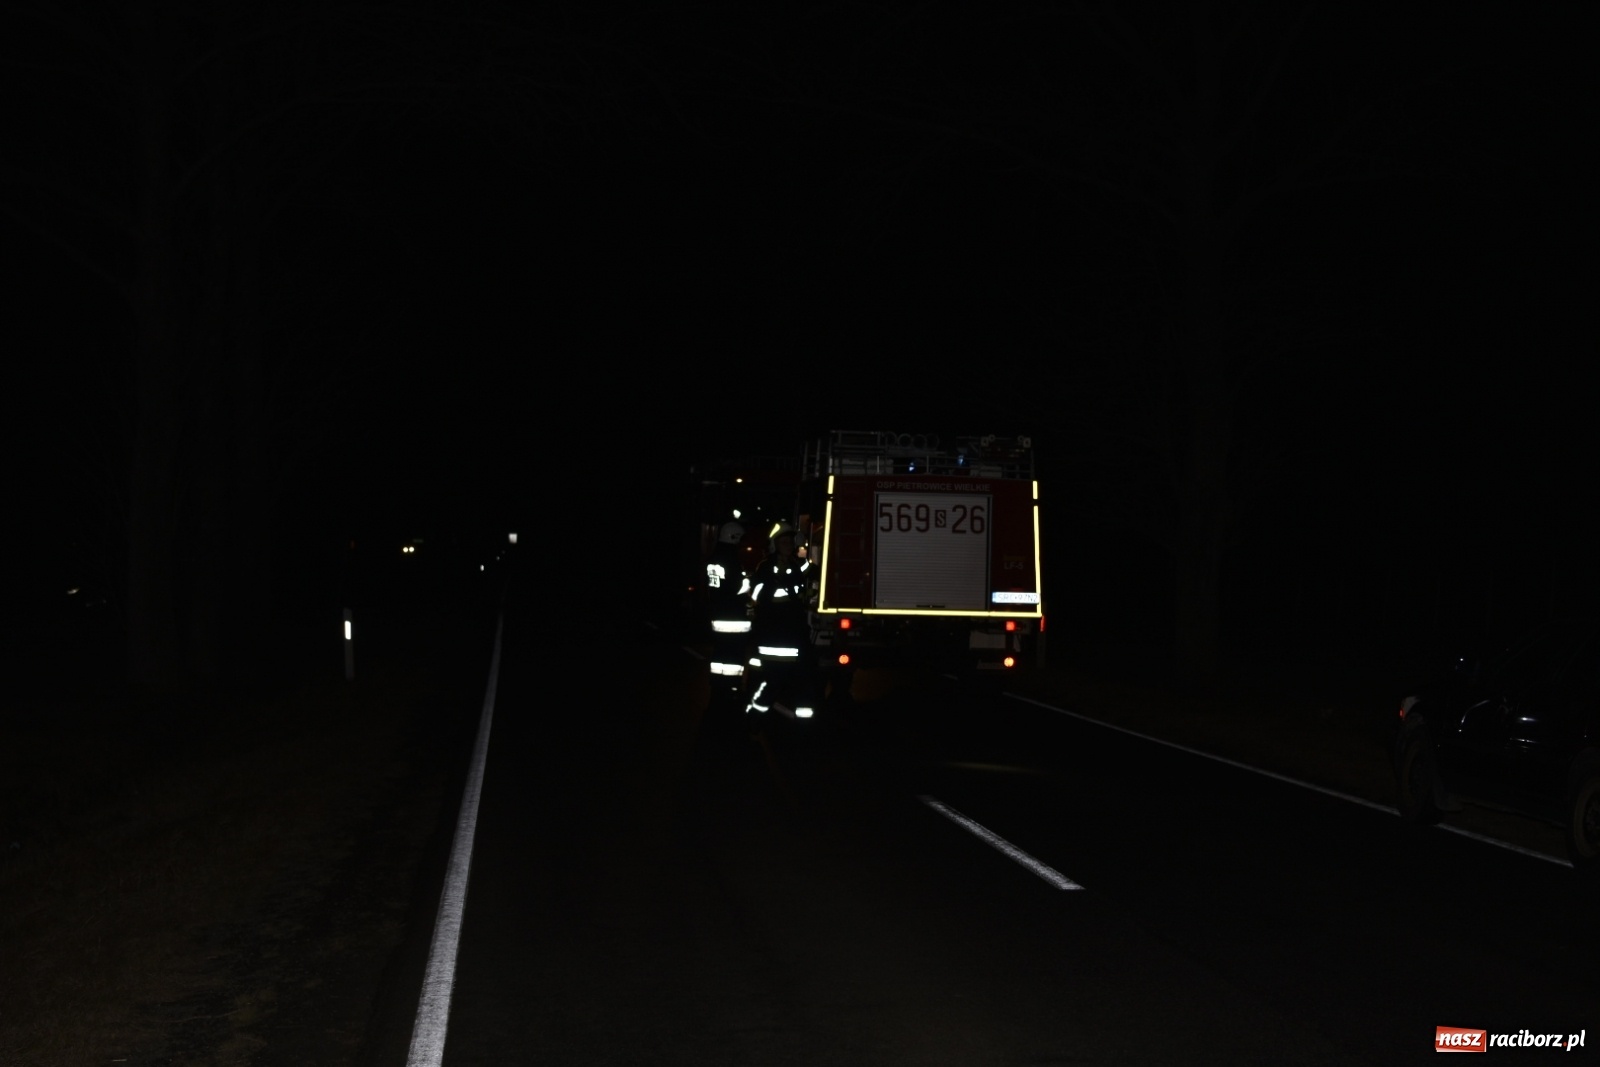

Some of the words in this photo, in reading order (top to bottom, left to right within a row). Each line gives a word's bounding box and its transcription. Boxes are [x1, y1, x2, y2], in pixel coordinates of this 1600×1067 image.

[877, 481, 895, 489] OSP
[897, 482, 952, 491] PIETROWICE
[954, 484, 990, 492] WIELKIE
[879, 503, 929, 533] 569
[936, 511, 945, 527] S
[952, 505, 984, 534] 26
